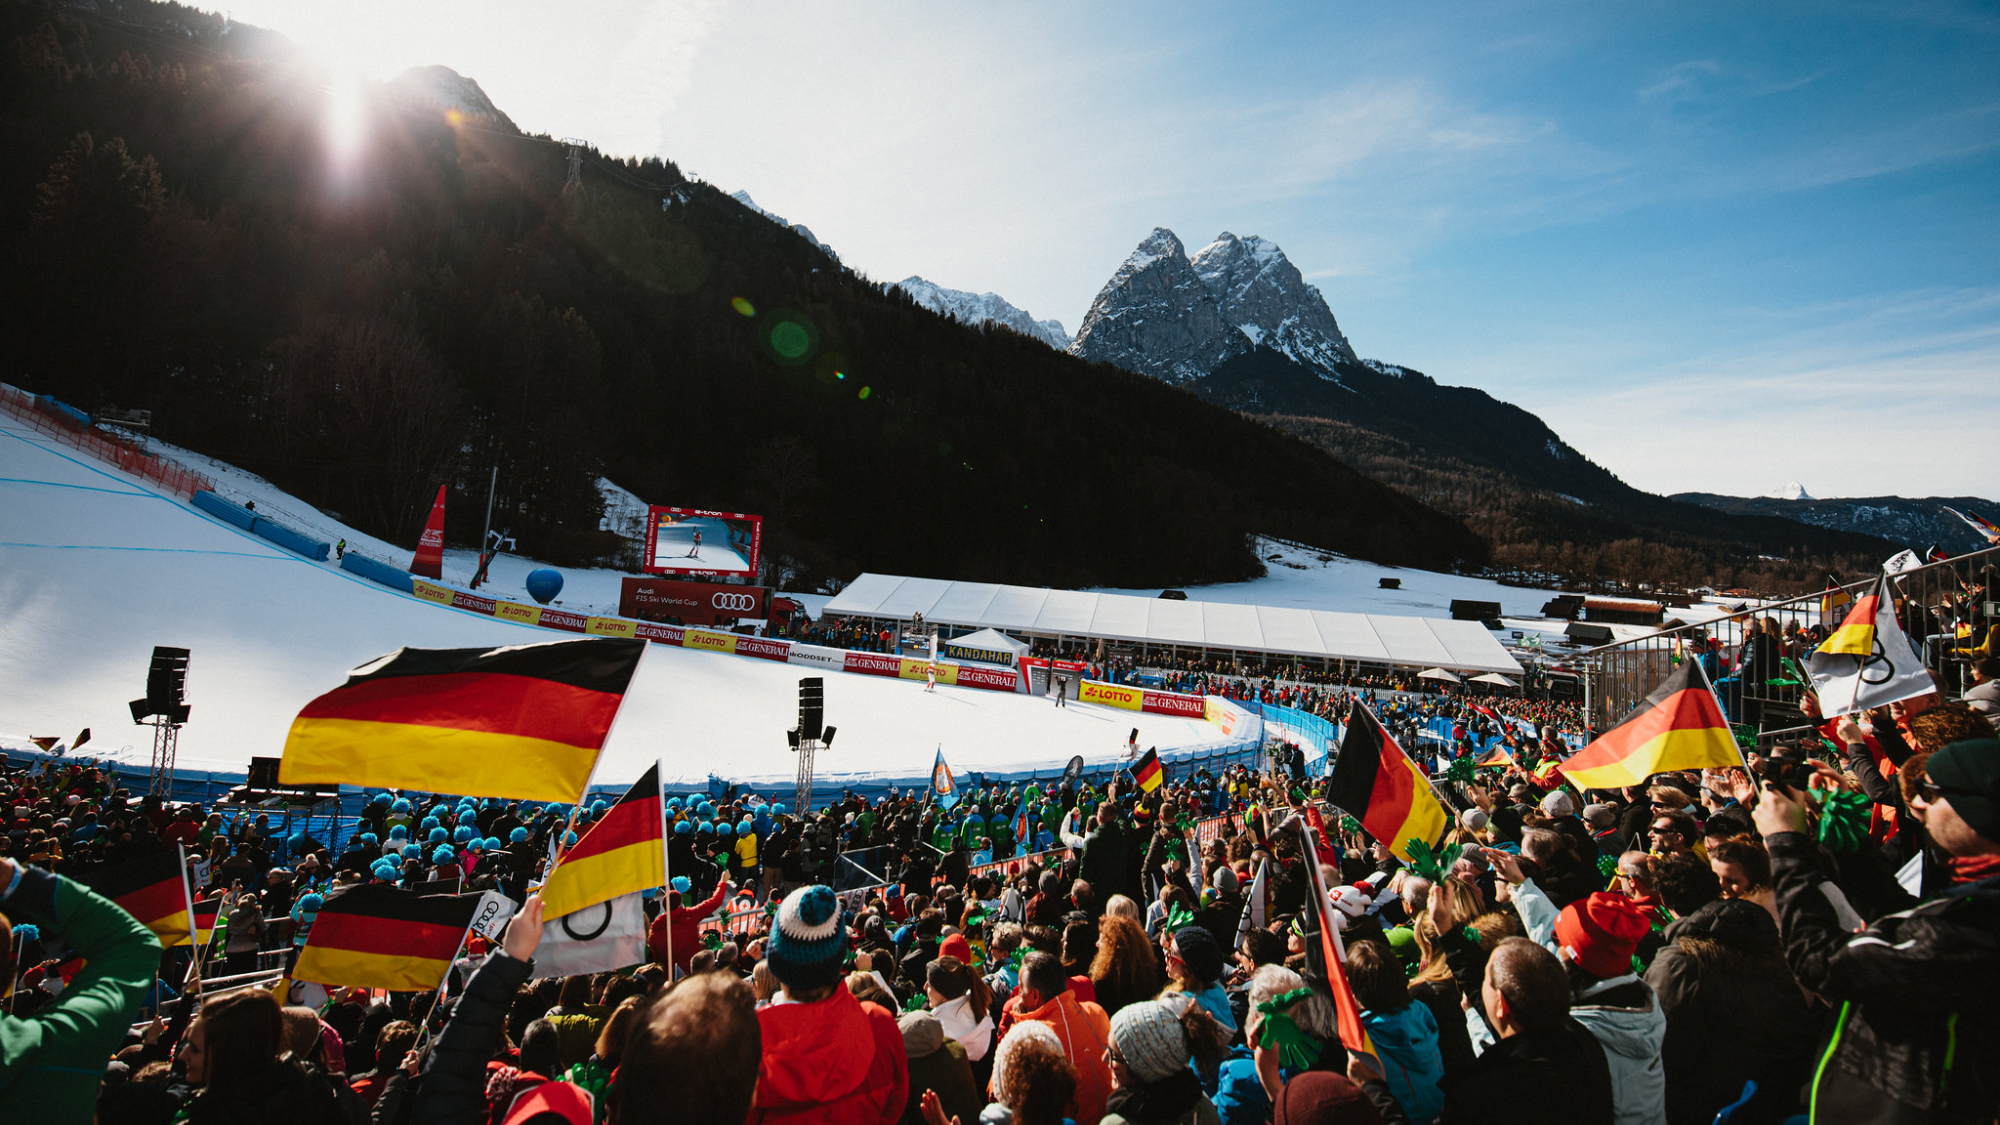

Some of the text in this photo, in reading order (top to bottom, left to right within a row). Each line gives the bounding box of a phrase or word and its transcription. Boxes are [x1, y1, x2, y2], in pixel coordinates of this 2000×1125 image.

[425, 588, 446, 600] LOTTO
[637, 587, 654, 595] Audi
[463, 599, 496, 613] GENERALI
[661, 597, 682, 605] World
[511, 608, 532, 618] LOTTO
[551, 615, 587, 628] GENERALI
[604, 623, 627, 632] LOTTO
[646, 628, 685, 641] GENERALI
[702, 637, 727, 647] LOTTO
[748, 642, 789, 657] GENERALI
[949, 646, 1011, 664] KANDAHAR
[797, 652, 832, 663] ODDSET
[858, 659, 900, 671] GENERALI
[920, 666, 946, 677] LOTO
[971, 673, 1016, 687] GENERALI
[1099, 689, 1133, 703] LOTTO
[1158, 698, 1204, 713] GENERAL
